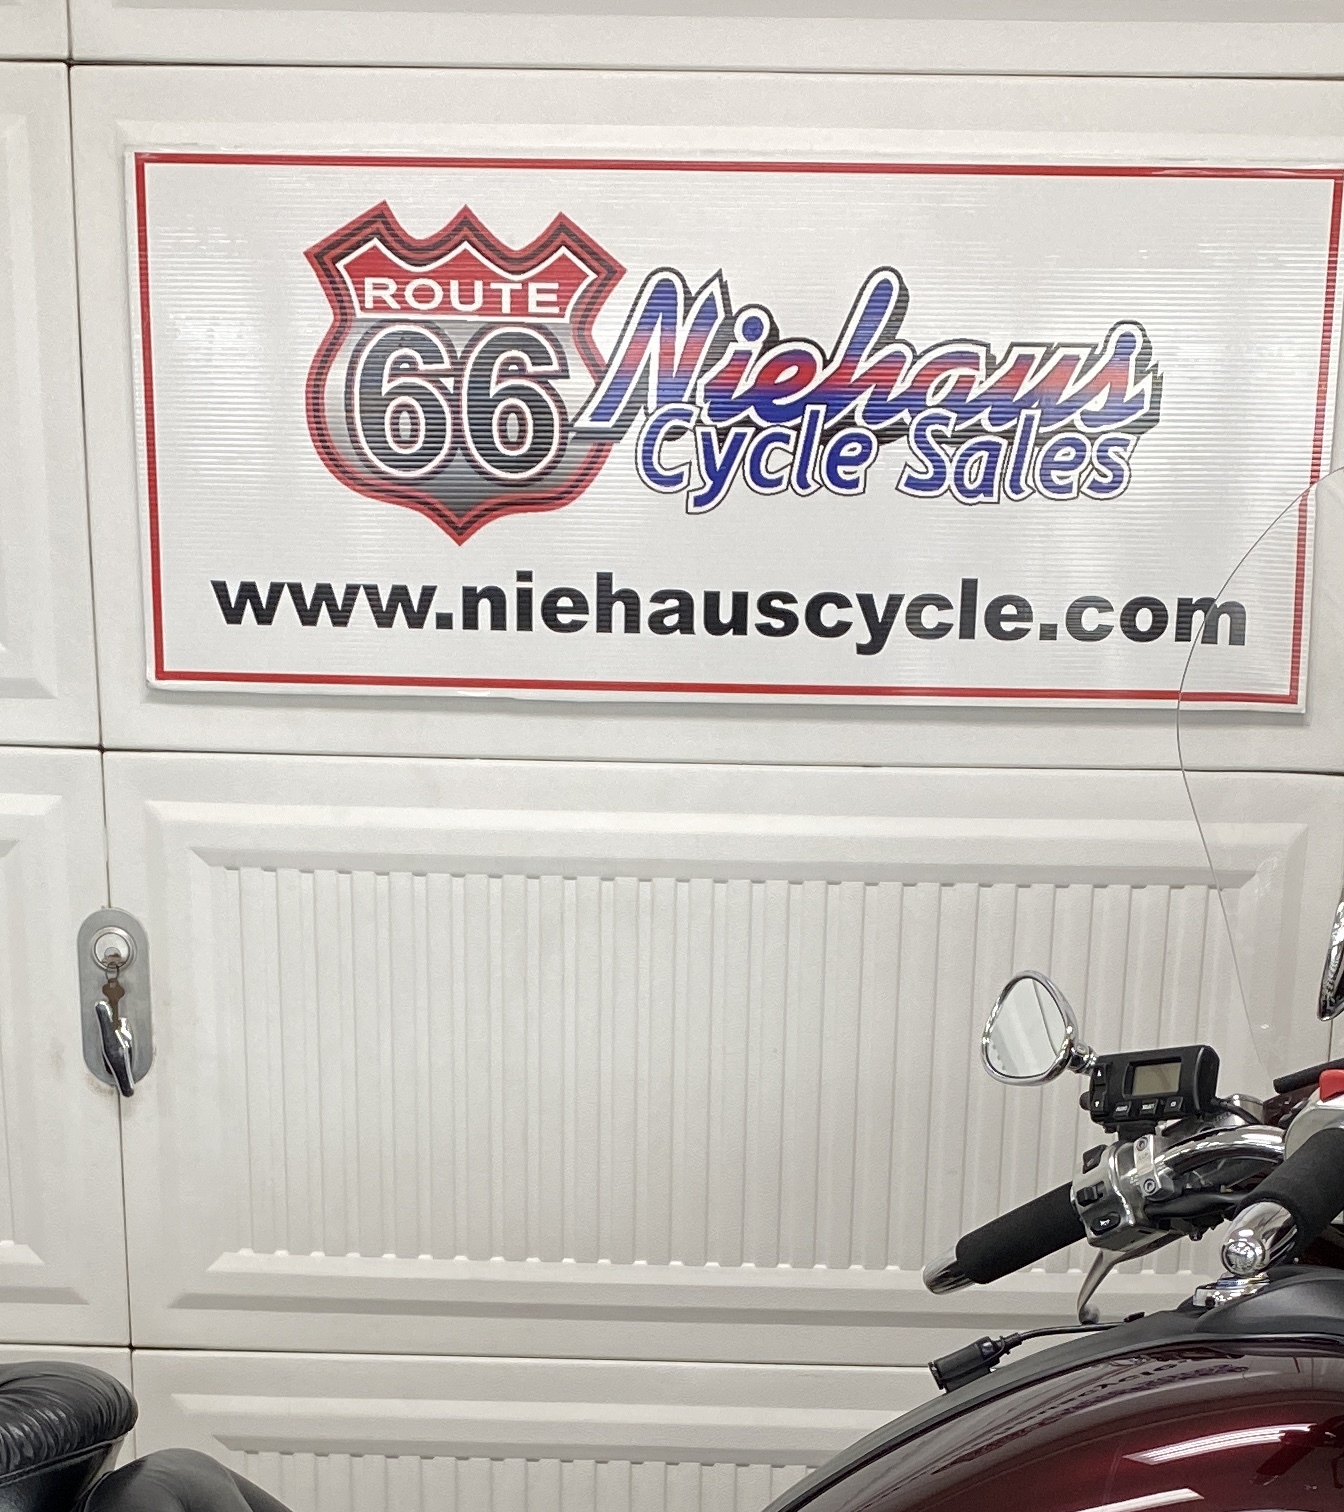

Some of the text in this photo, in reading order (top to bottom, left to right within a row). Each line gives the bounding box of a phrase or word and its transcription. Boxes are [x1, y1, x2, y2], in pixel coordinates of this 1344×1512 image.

[363, 277, 560, 315] ROUTE
[347, 321, 569, 484] 66
[574, 266, 1162, 440] Niehaus
[635, 402, 1138, 514] Cycle Sales
[211, 571, 1248, 655] www.niehauscycle.com
